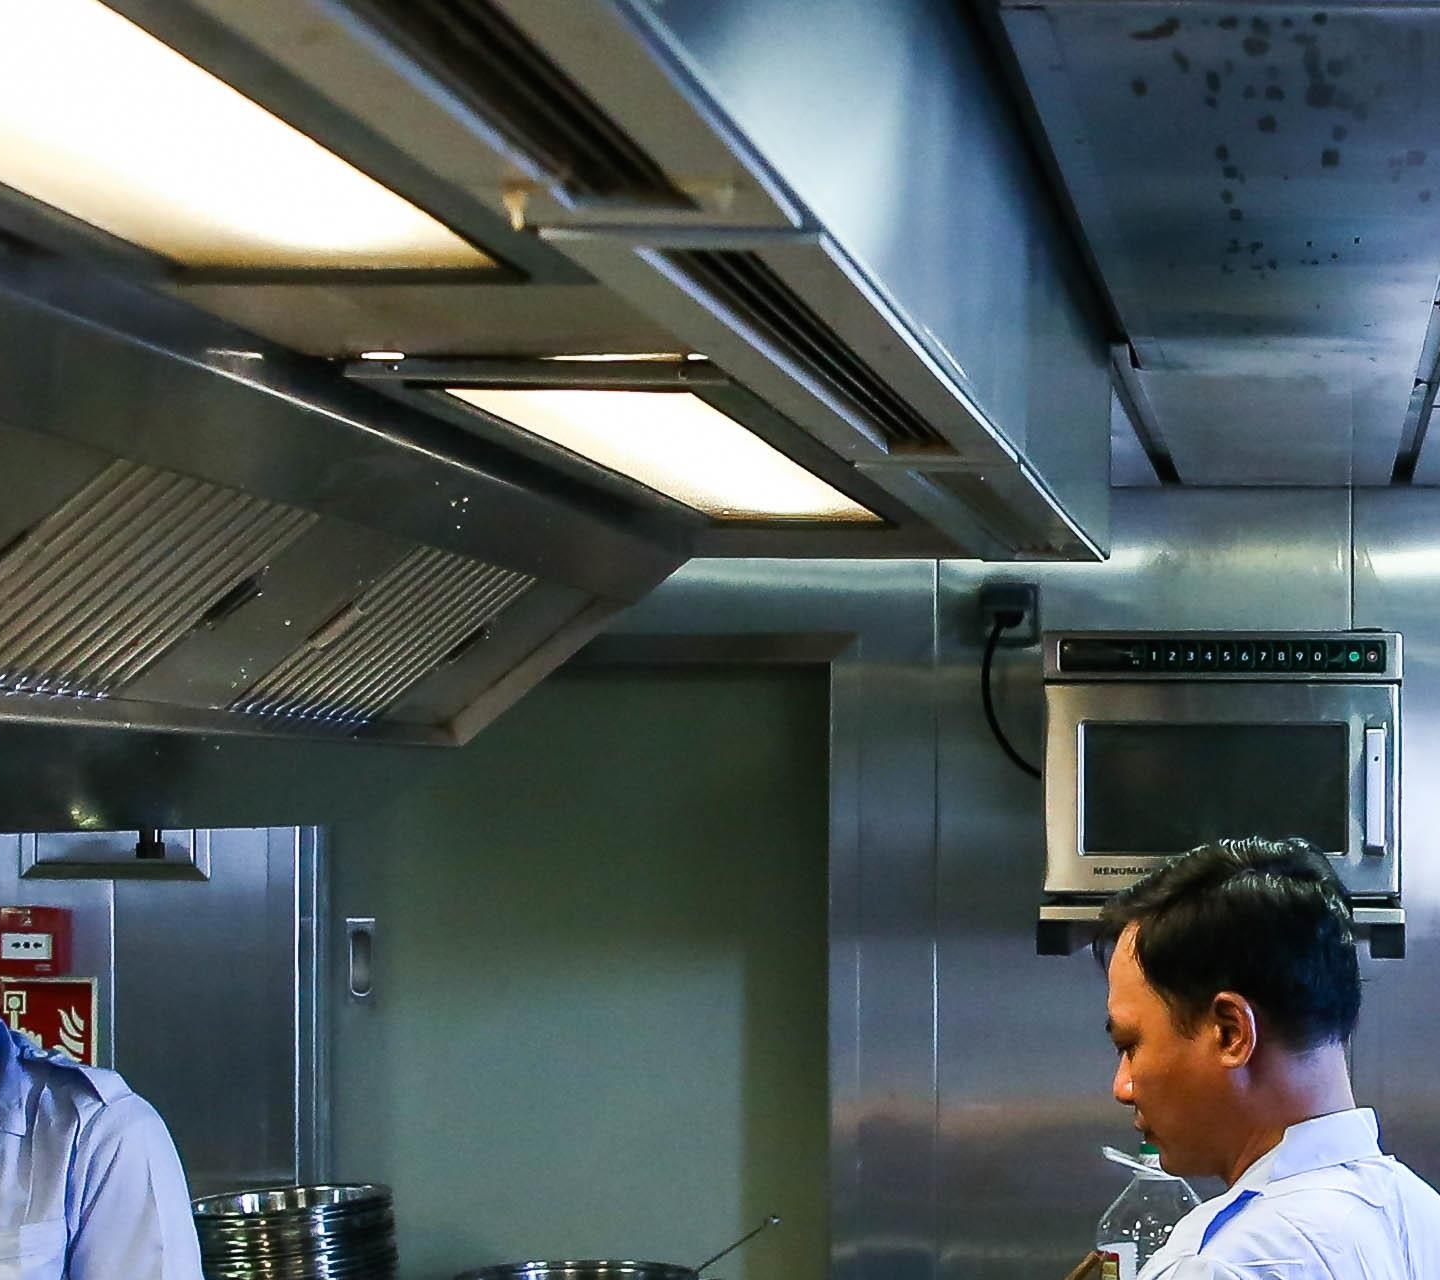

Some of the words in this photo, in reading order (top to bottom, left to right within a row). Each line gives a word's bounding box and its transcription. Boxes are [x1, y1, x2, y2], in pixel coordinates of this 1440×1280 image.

[1168, 651, 1176, 661] 2
[1187, 651, 1194, 661] 3
[1204, 651, 1212, 661] 4
[1223, 651, 1231, 661] 5
[1241, 651, 1249, 661] 6
[1260, 651, 1267, 661] 7
[1278, 651, 1285, 661] 8
[1295, 651, 1303, 661] 9
[1314, 651, 1322, 661] 0
